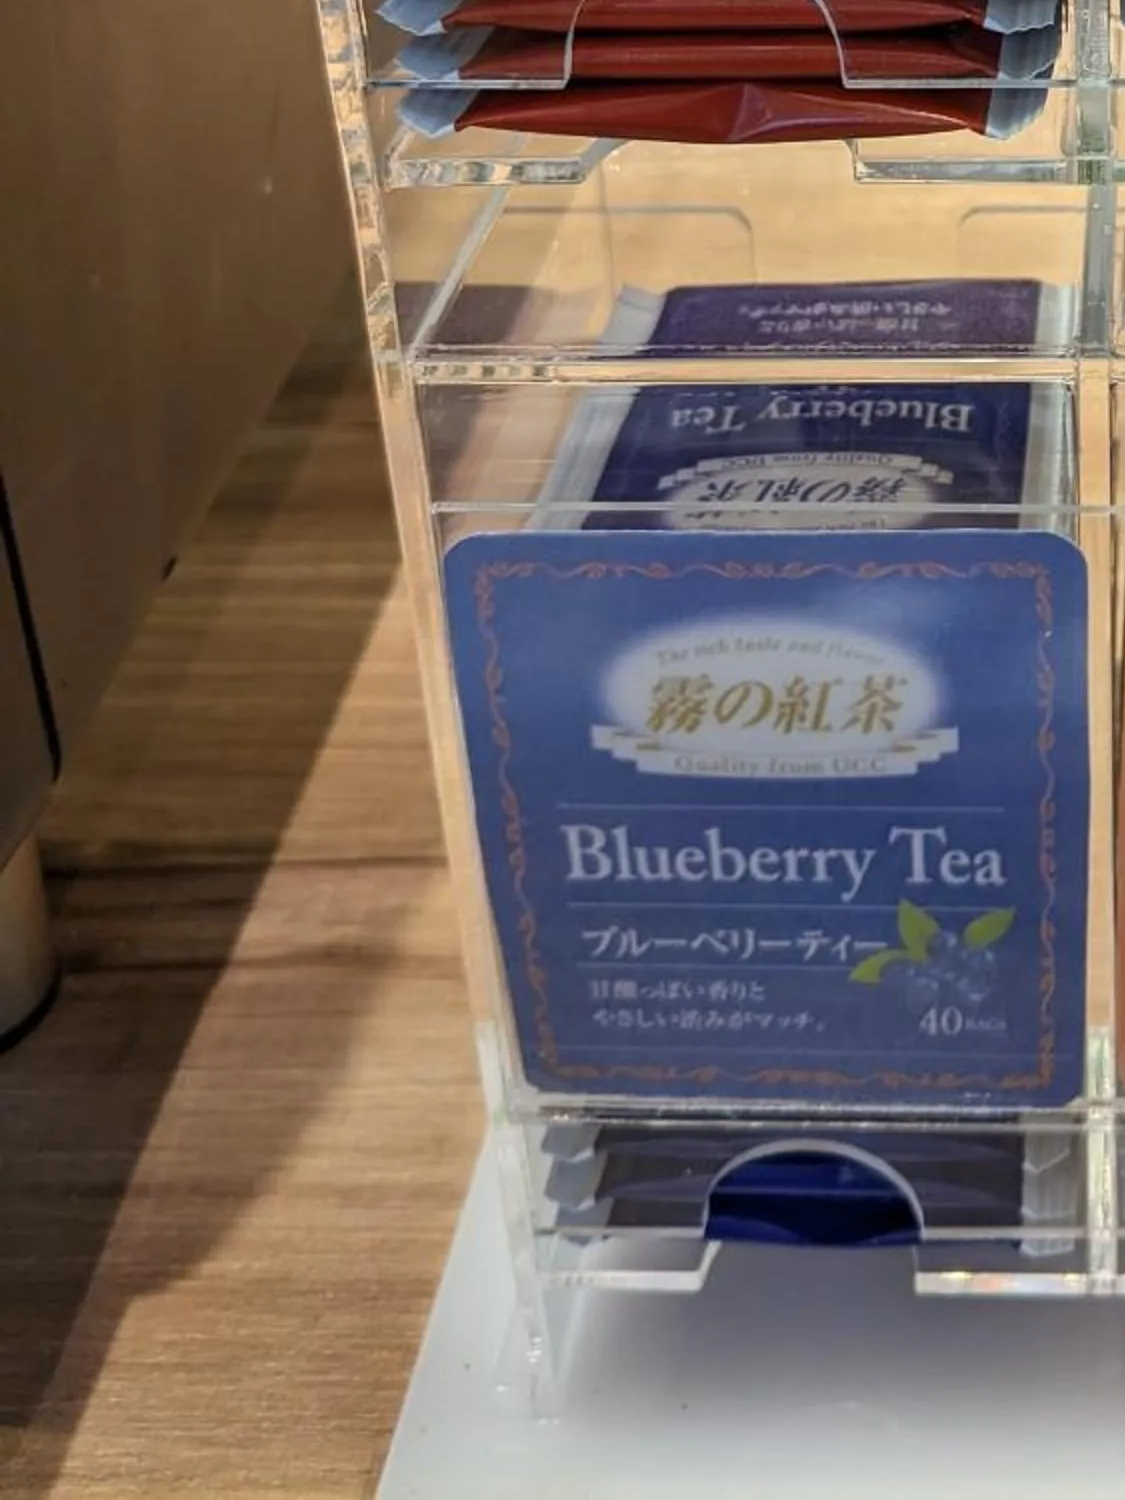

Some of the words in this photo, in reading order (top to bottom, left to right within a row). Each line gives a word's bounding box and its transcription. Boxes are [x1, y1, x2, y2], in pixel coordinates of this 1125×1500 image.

[667, 405, 750, 435] Tea
[757, 393, 977, 433] Blueberry
[646, 672, 910, 735] 霧の紅茶
[560, 823, 877, 902] Blueberry
[888, 826, 1008, 887] Tea
[582, 927, 890, 962] ブルーベリーティー
[919, 1006, 963, 1037] 40
